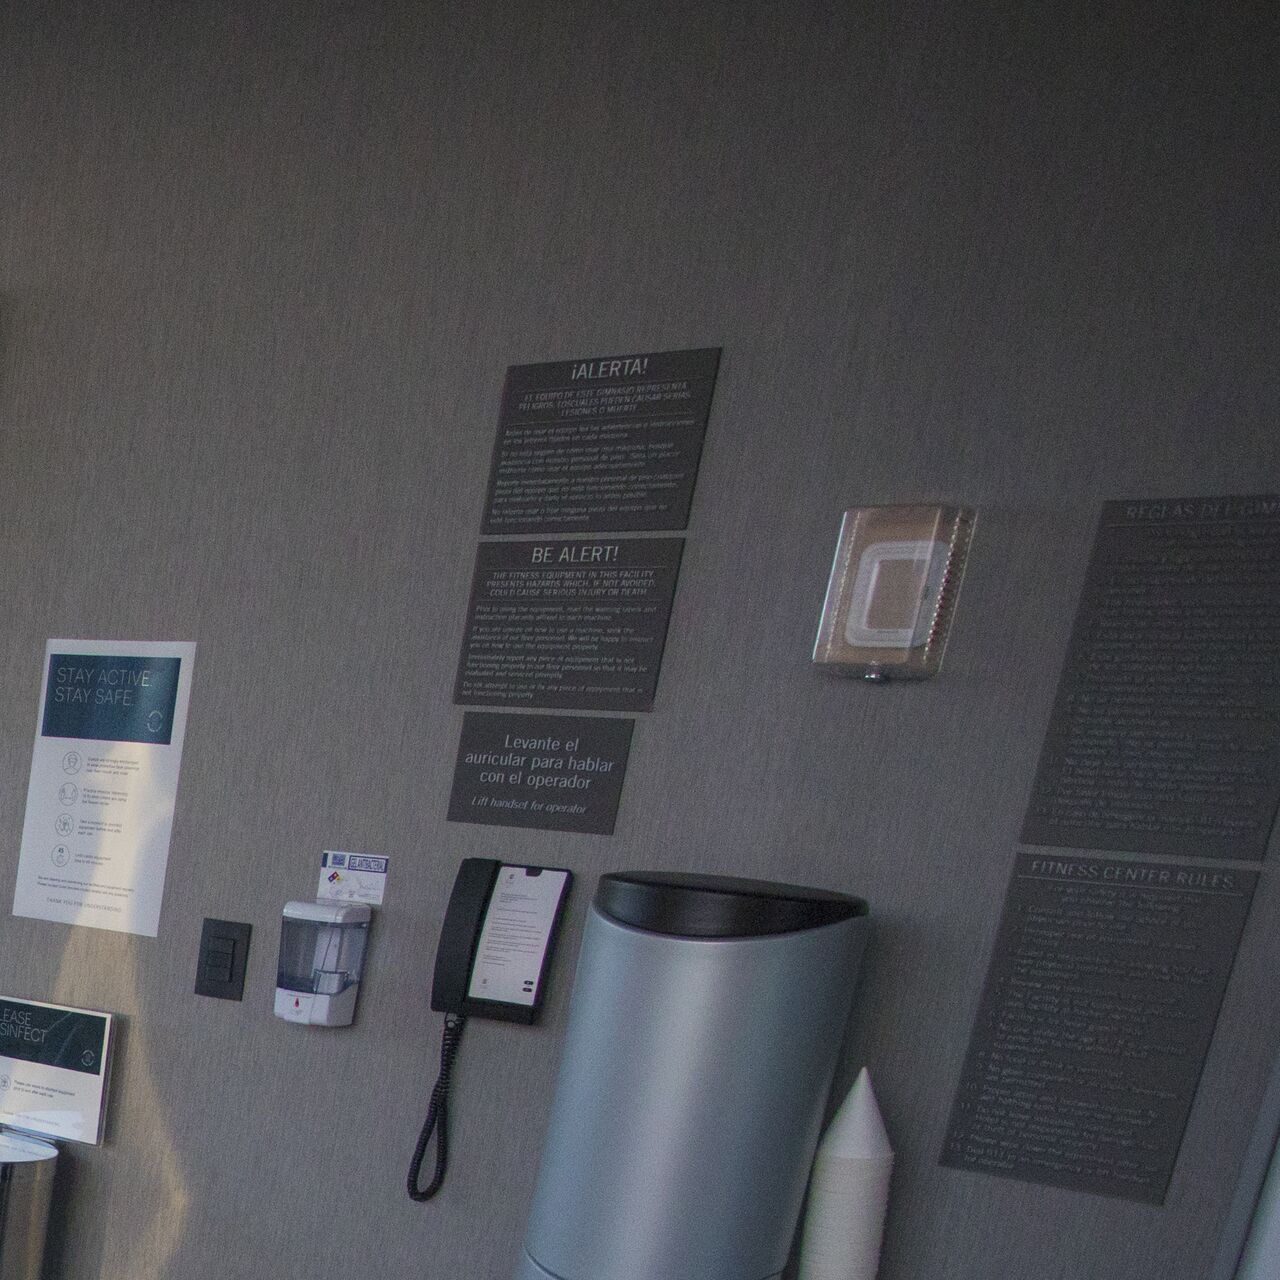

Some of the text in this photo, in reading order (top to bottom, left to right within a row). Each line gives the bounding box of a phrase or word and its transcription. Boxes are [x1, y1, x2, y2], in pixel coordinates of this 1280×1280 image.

[572, 357, 647, 380] ¡ALERTA!
[530, 545, 619, 563] BE ALERT!
[508, 571, 540, 579] FITNESS
[541, 571, 586, 579] EQUIPMENT
[588, 571, 597, 579] IN
[598, 570, 617, 578] THIS
[618, 570, 654, 578] FACILITY
[56, 666, 94, 684] STAY
[54, 686, 91, 703] STAY
[504, 734, 580, 752] Levante el
[464, 751, 614, 773] auricular para hablar
[479, 771, 593, 790] con el operador
[490, 797, 528, 810] handset
[530, 800, 544, 811] for
[545, 802, 587, 815] operator
[1031, 859, 1235, 890] FITNESS CENTER RULES
